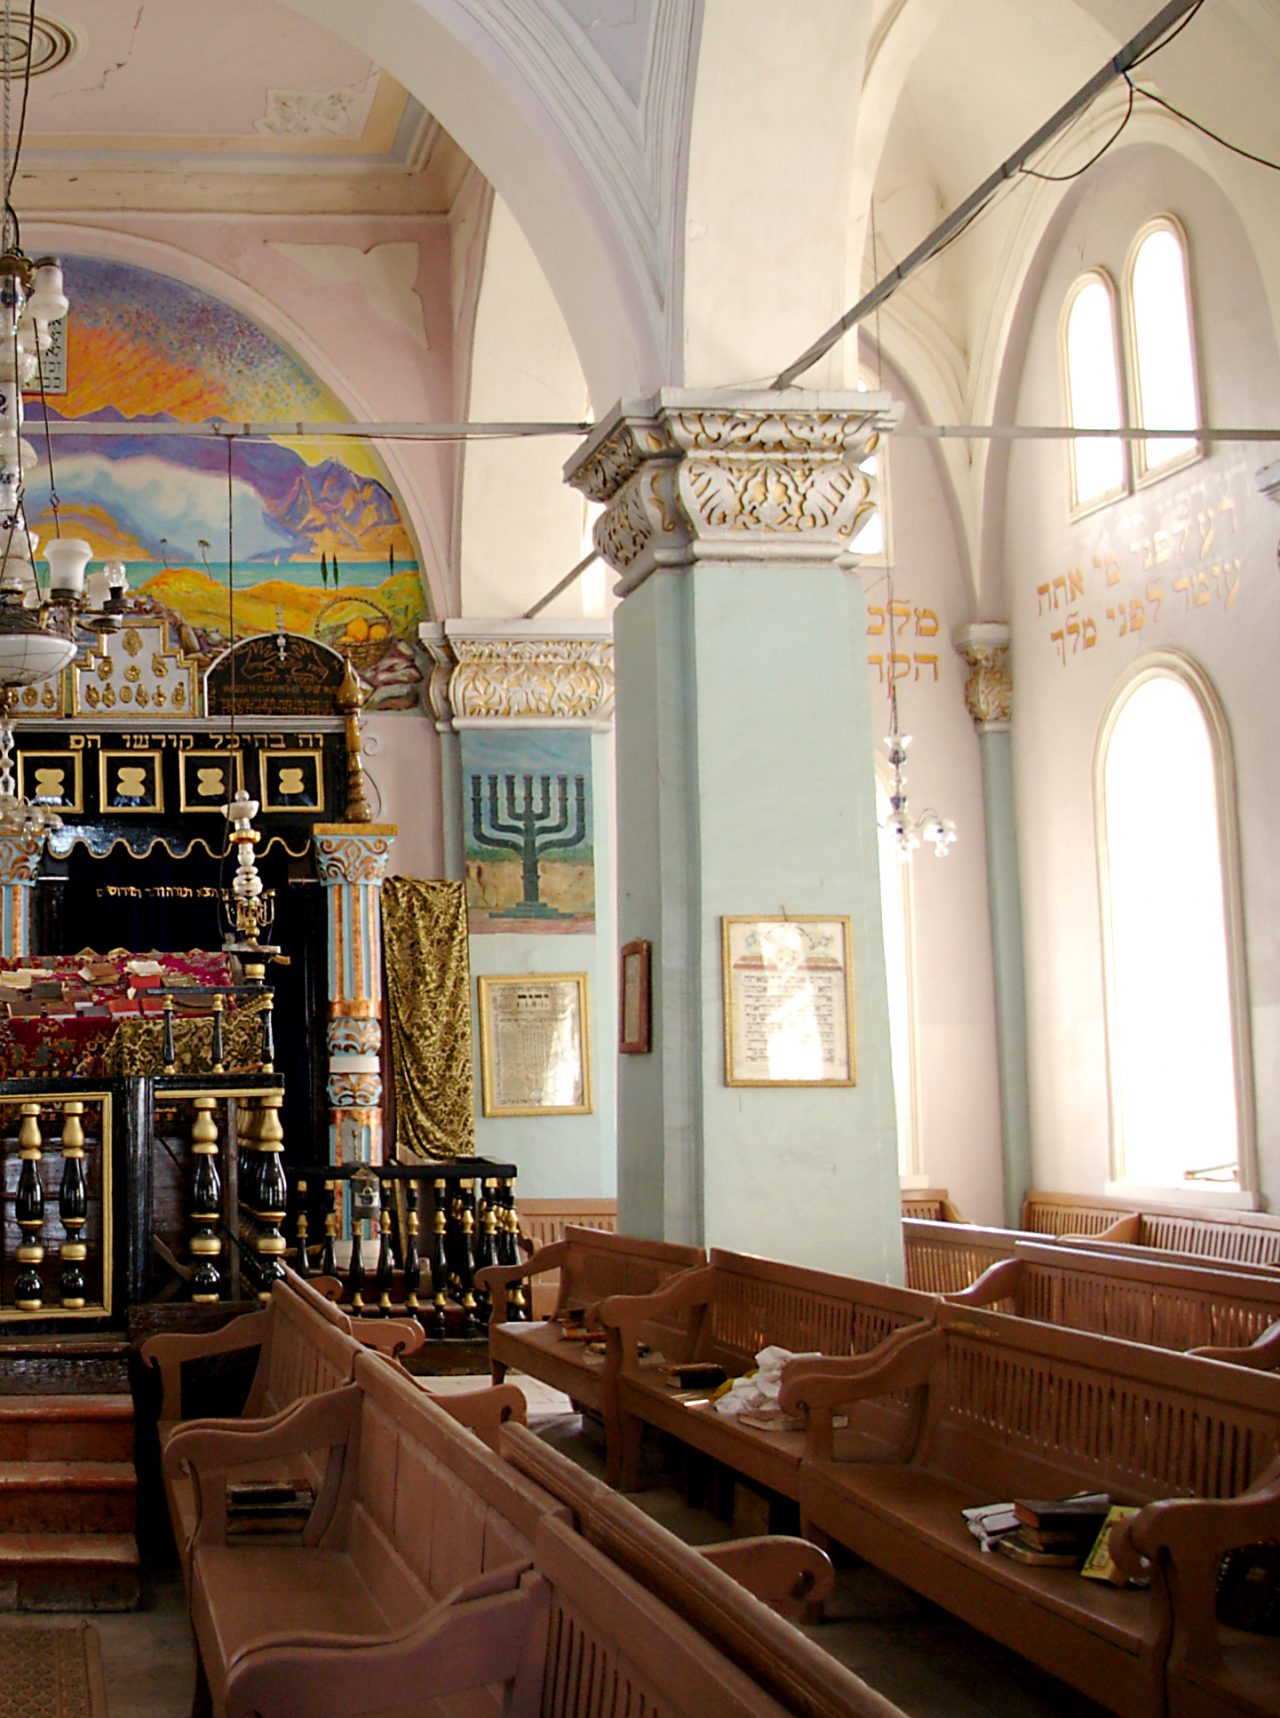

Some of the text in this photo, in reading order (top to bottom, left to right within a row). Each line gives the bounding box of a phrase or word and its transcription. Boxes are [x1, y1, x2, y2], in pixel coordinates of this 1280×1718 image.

[1037, 567, 1085, 617] אתה
[1106, 577, 1165, 638] לפני
[866, 599, 939, 637] מלכ
[1050, 611, 1098, 668] מלך
[866, 652, 939, 700] הקד
